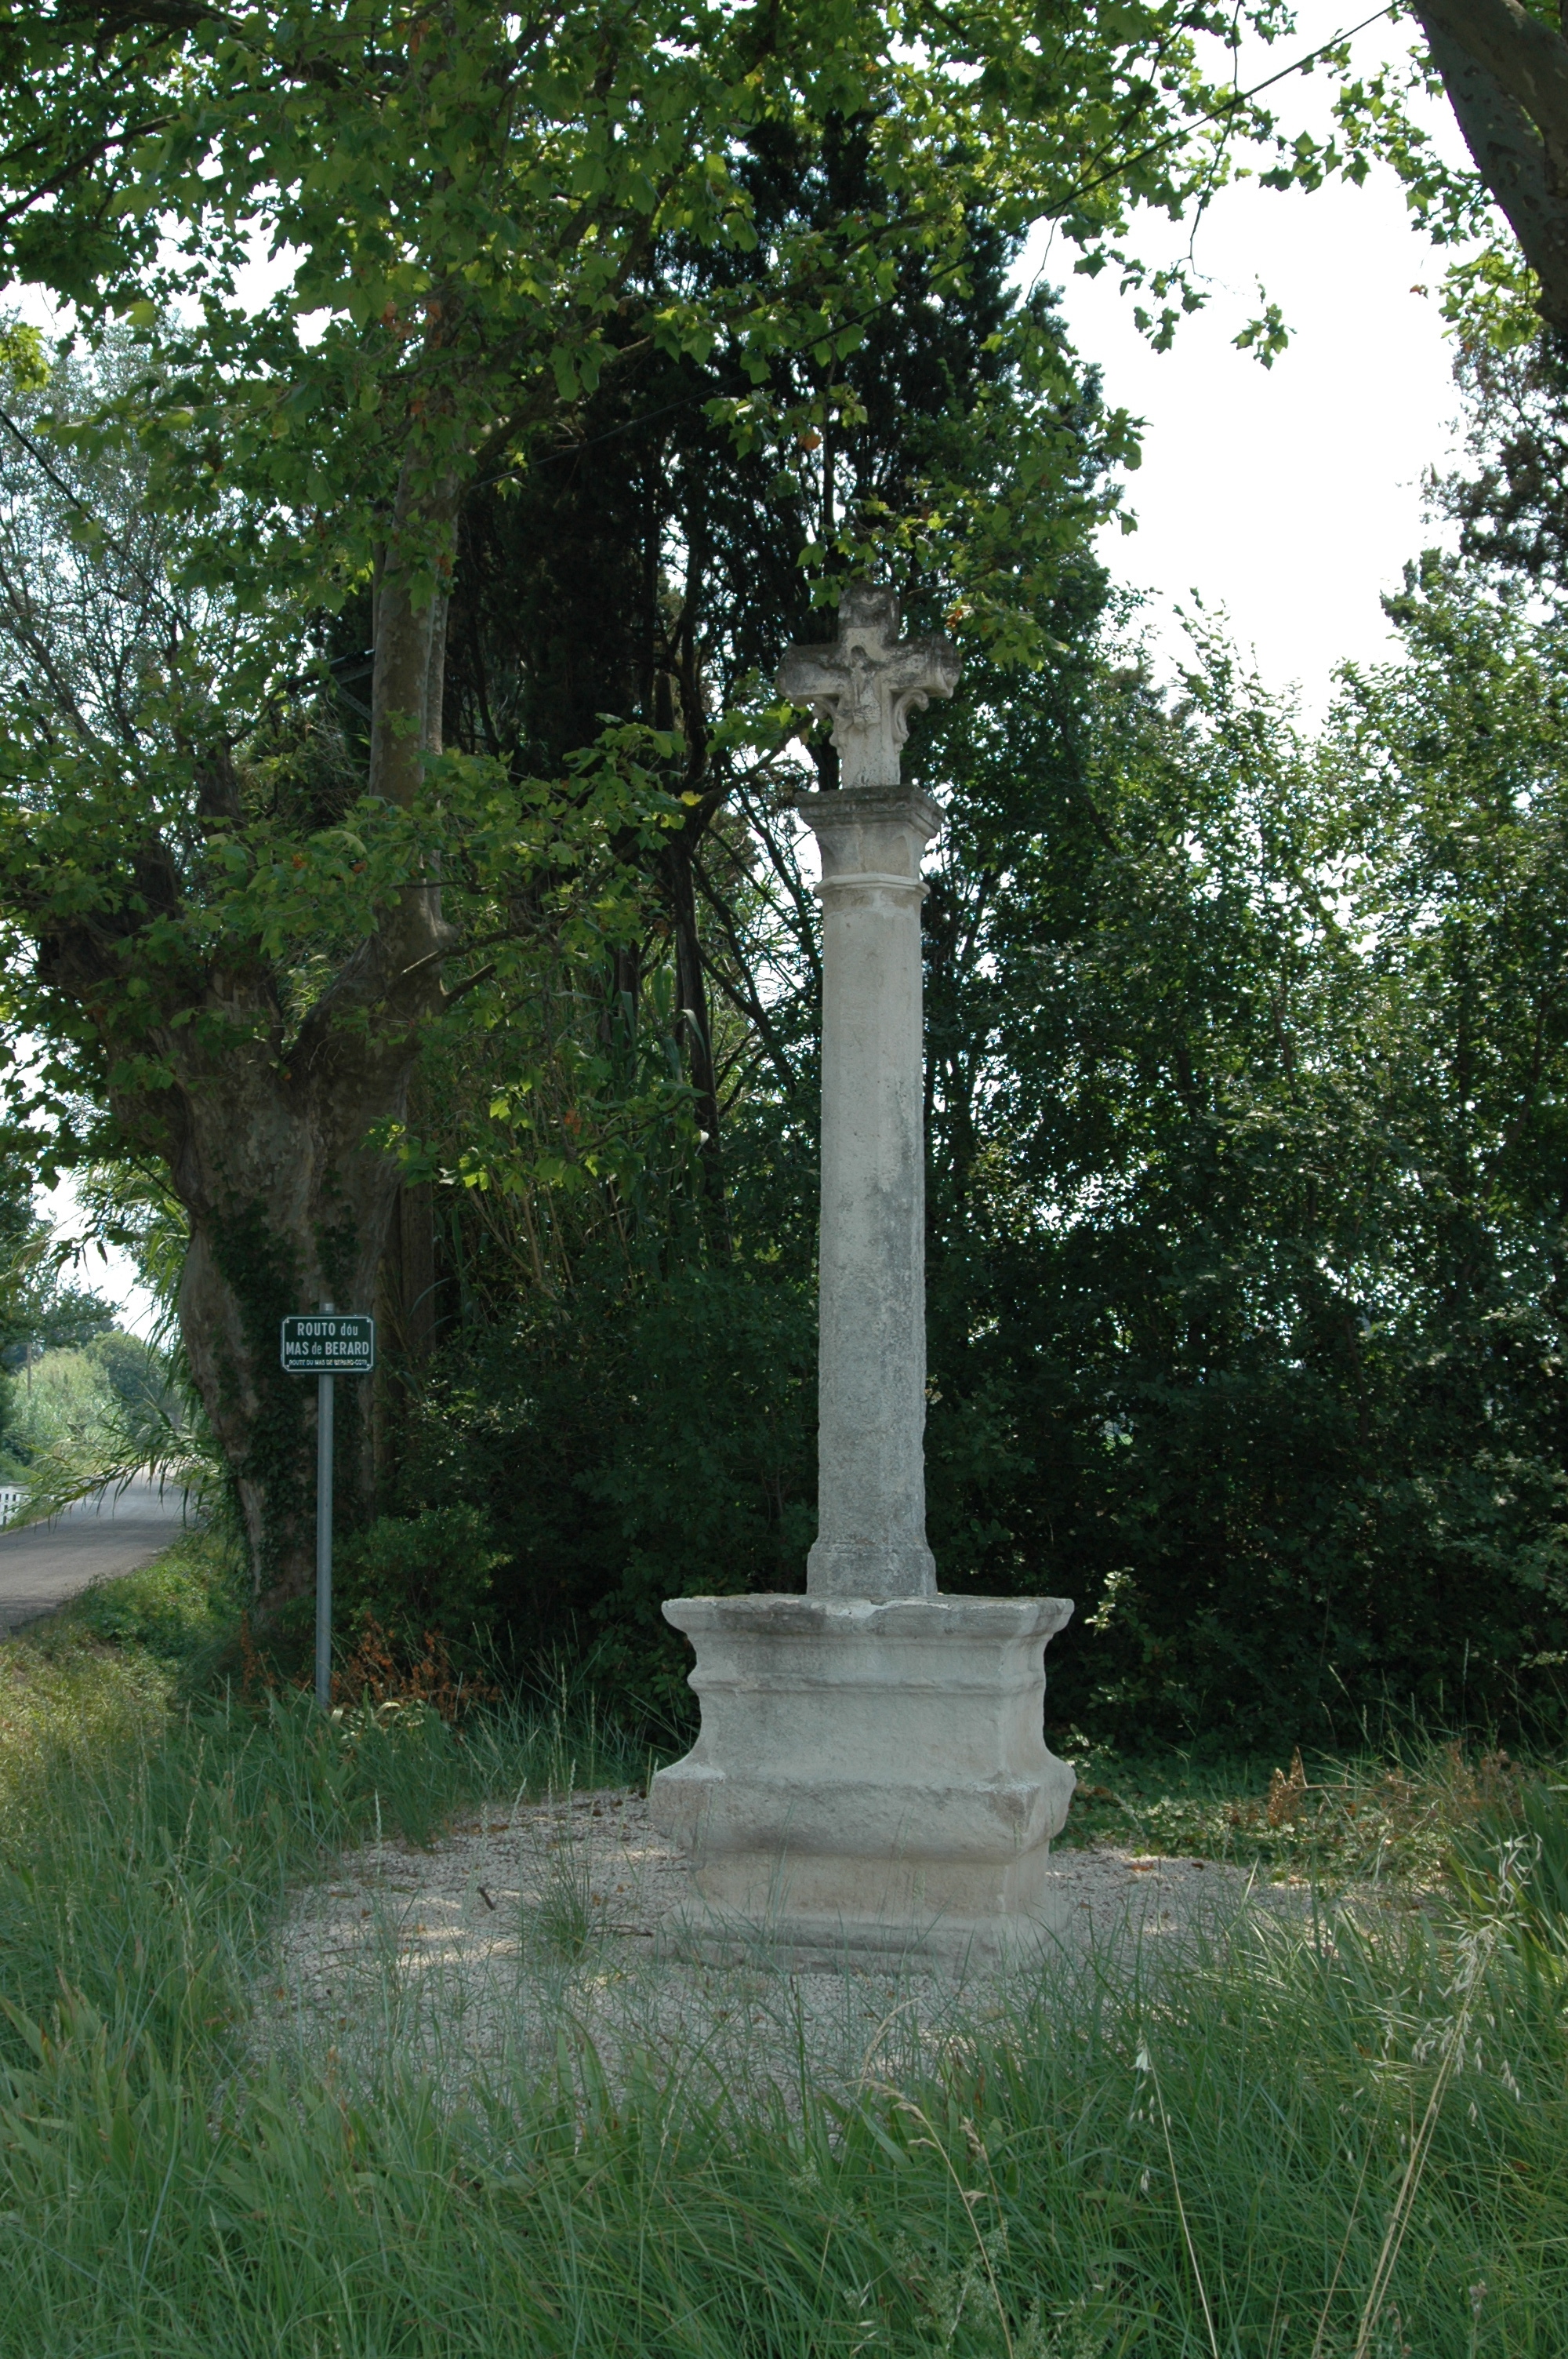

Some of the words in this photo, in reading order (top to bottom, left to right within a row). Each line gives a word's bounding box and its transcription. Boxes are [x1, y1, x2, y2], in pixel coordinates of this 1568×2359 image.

[297, 1322, 336, 1336] ROUTO
[285, 1341, 309, 1355] MAS
[311, 1341, 322, 1355] de
[325, 1341, 369, 1355] BERARD
